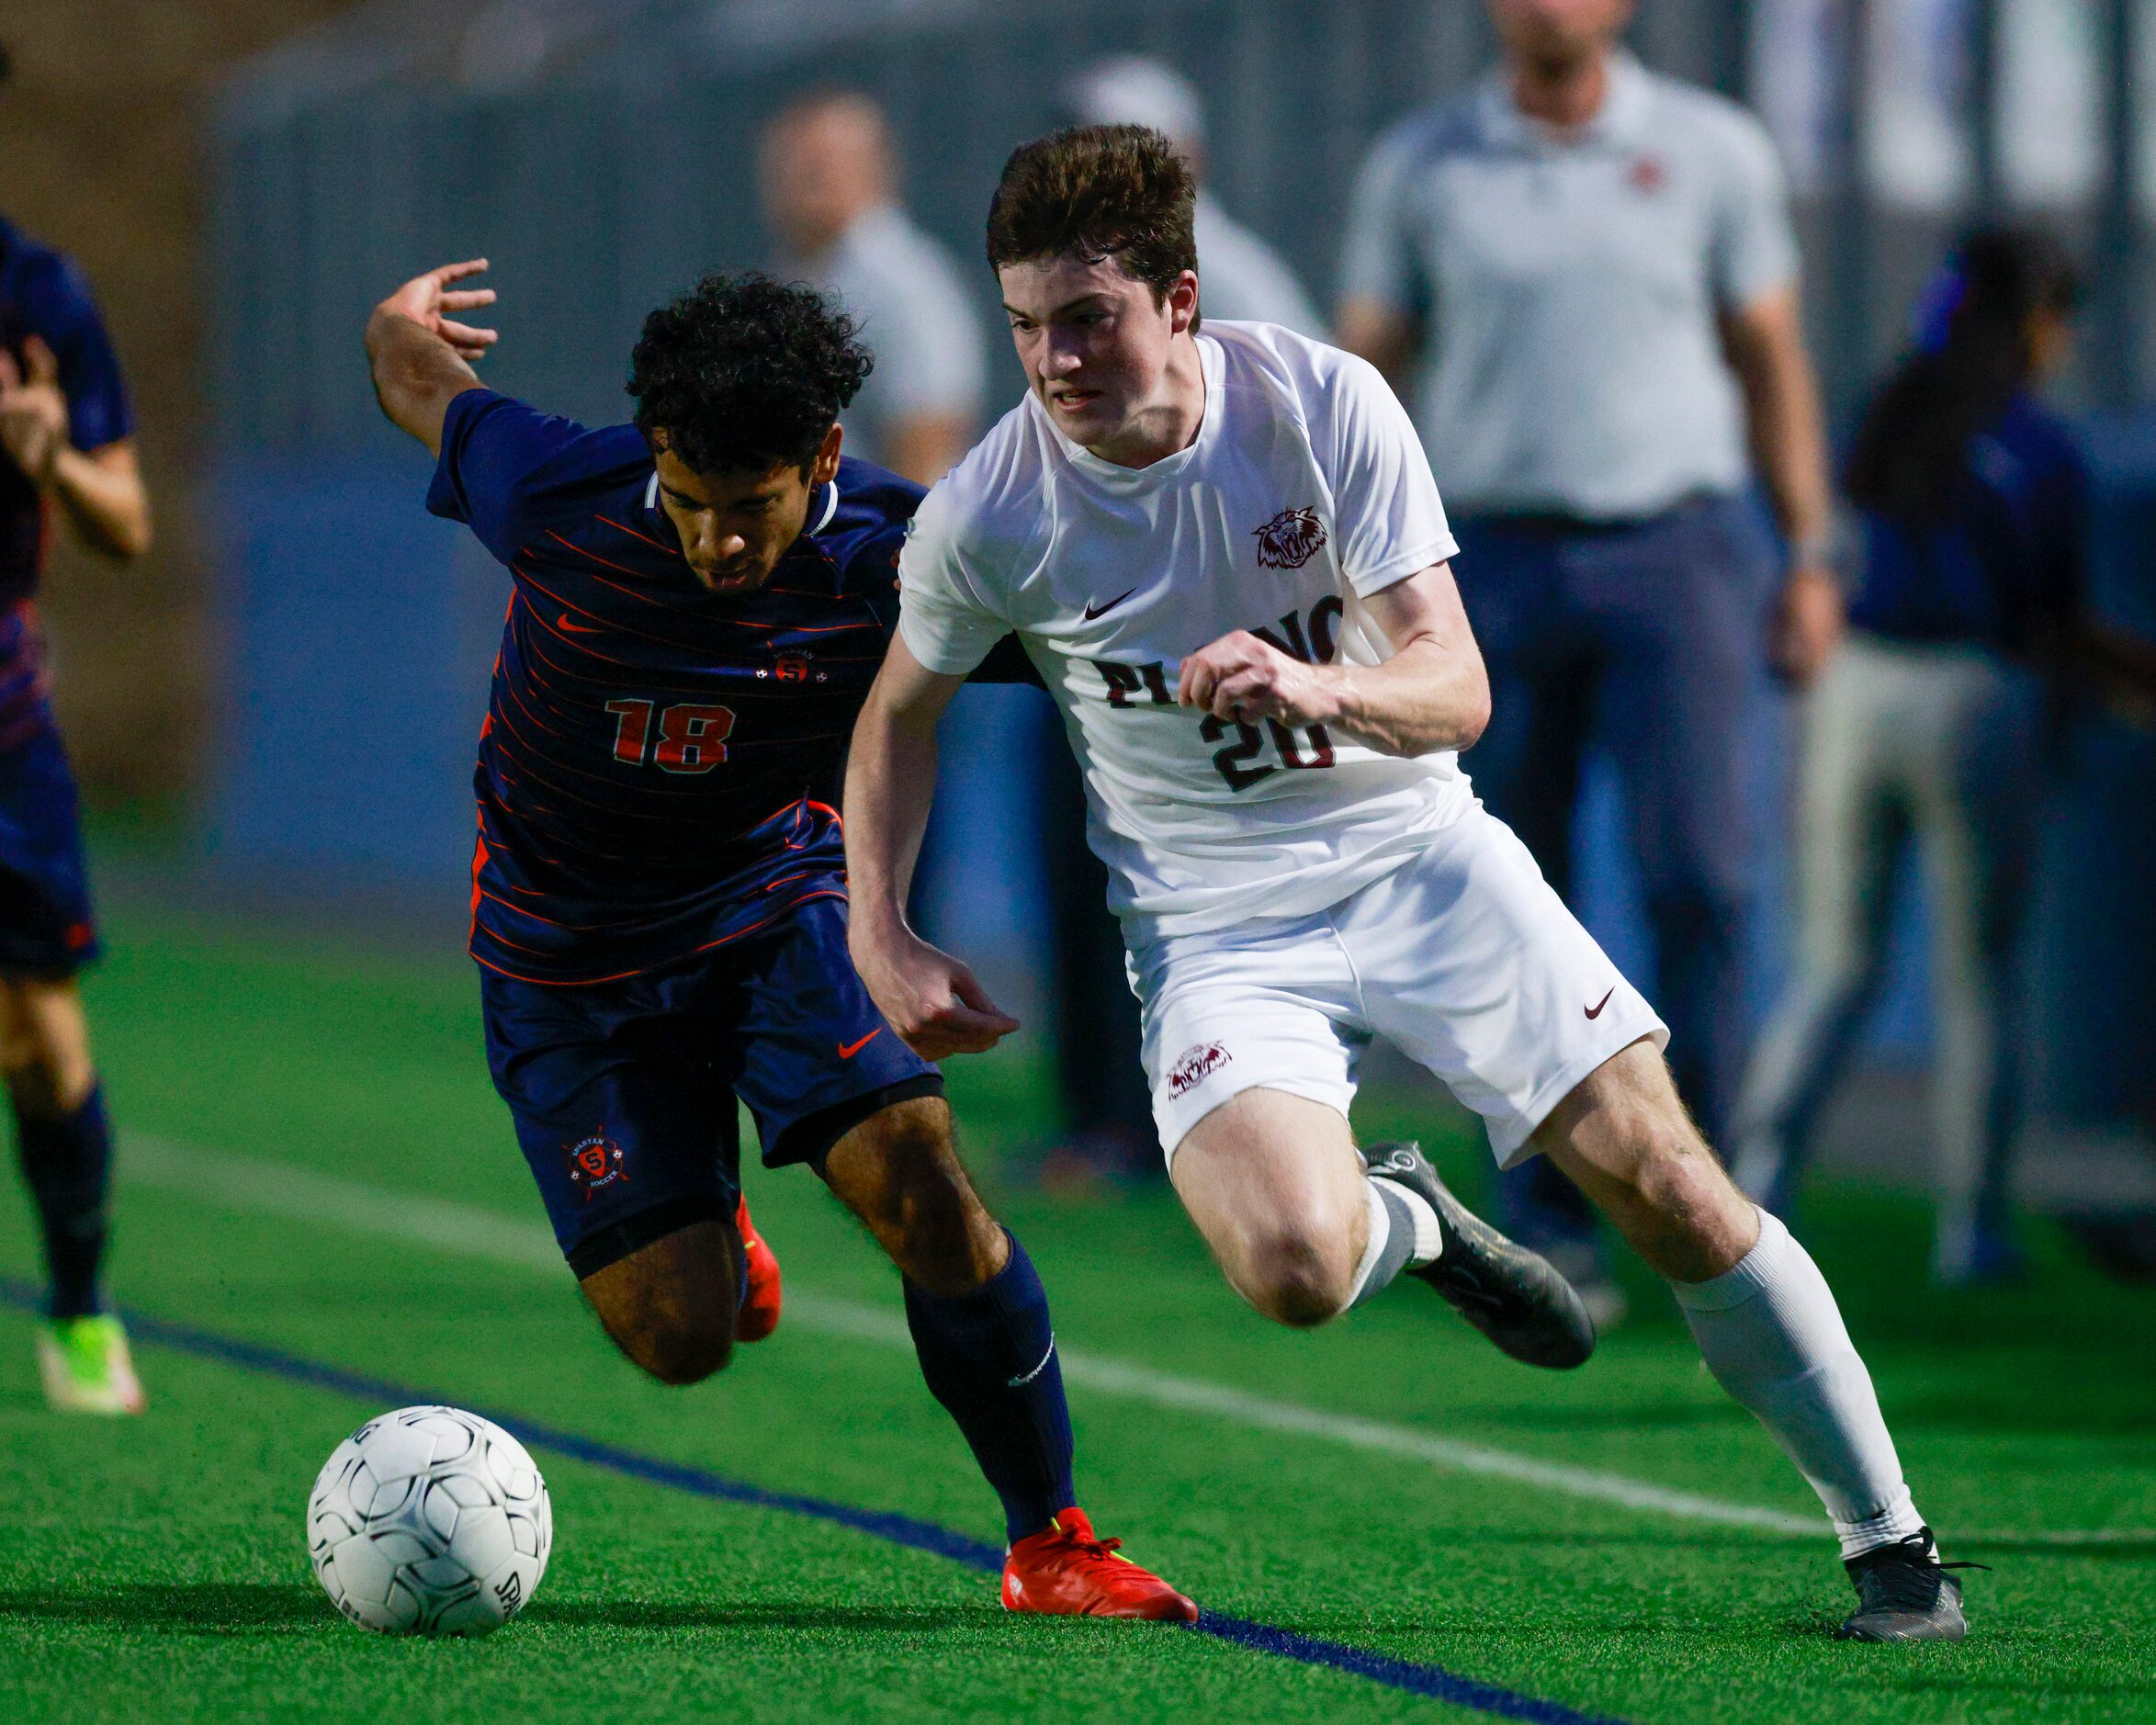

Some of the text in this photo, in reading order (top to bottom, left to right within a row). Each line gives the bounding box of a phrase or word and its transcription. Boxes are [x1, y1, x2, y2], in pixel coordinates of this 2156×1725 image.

[1091, 595, 1344, 709] PLNO
[604, 698, 736, 774] 18
[1199, 713, 1337, 793] 20
[585, 1152, 603, 1170] S
